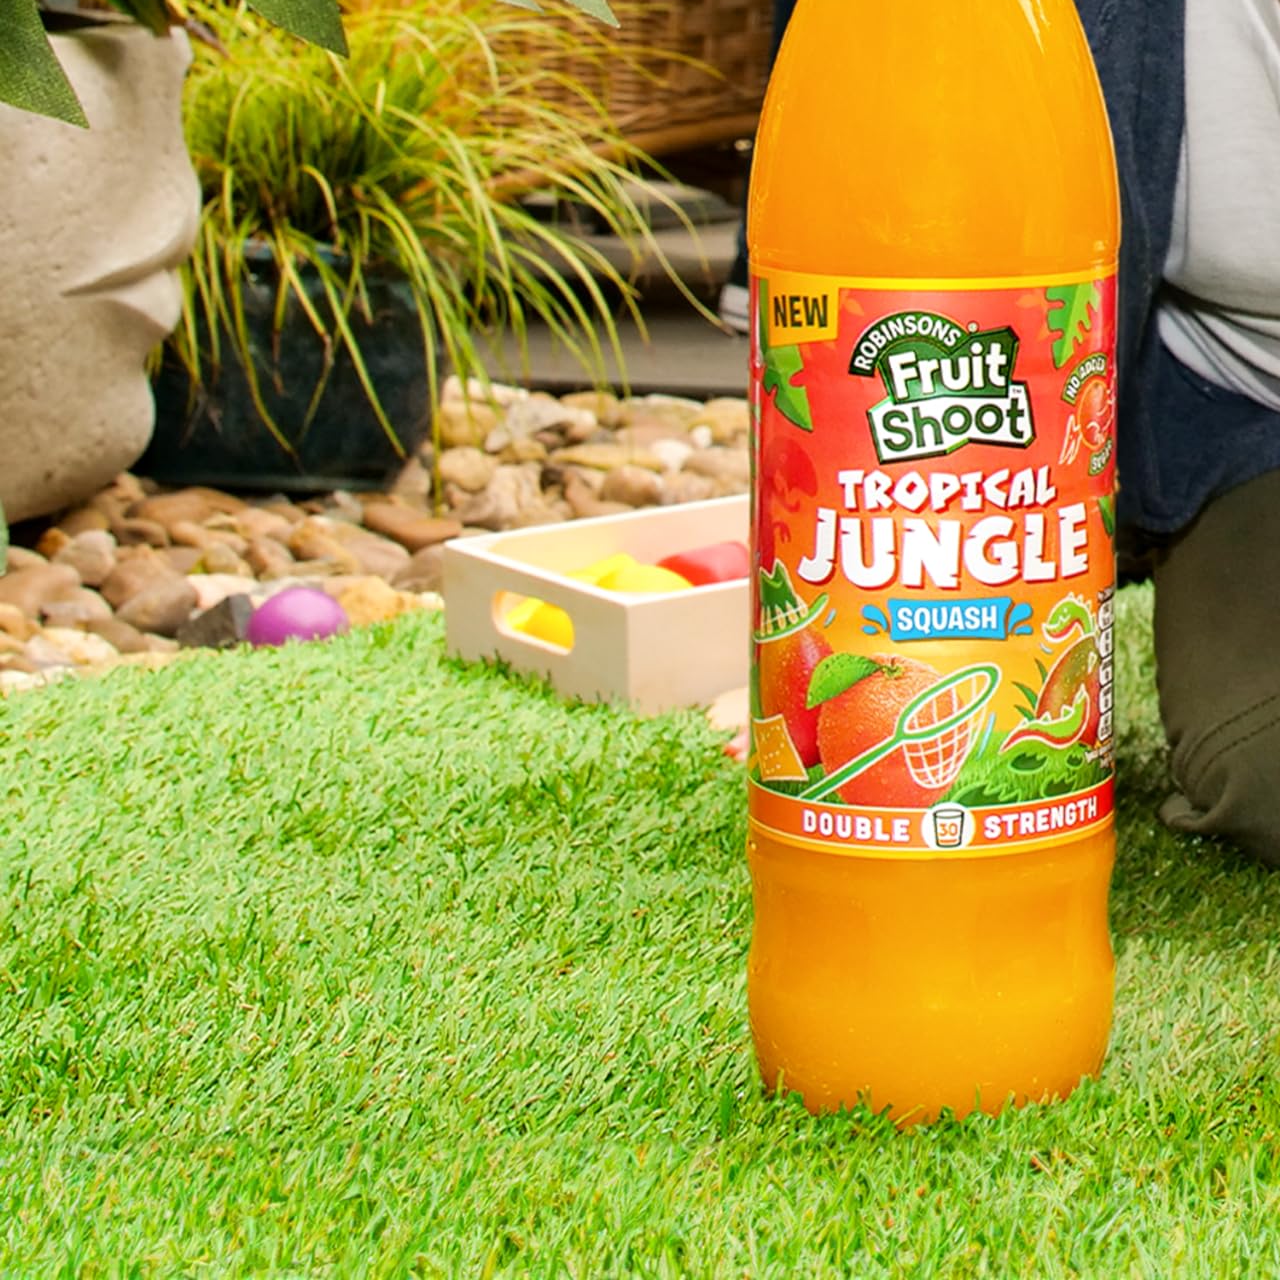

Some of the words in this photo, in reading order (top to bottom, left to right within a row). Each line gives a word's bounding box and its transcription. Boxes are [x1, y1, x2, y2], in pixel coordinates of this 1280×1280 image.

[773, 294, 828, 328] NEW
[853, 315, 962, 371] ROBINSONS
[887, 341, 1008, 400] Fruit
[1066, 375, 1081, 398] NO
[881, 397, 1026, 452] Shoot
[837, 465, 1057, 512] TROPICAL
[797, 502, 1090, 588] JUNGLE
[896, 605, 998, 635] SQUASH
[802, 808, 911, 842] DOUBLE
[983, 795, 1098, 840] STRENGTH
[938, 822, 959, 838] 30
